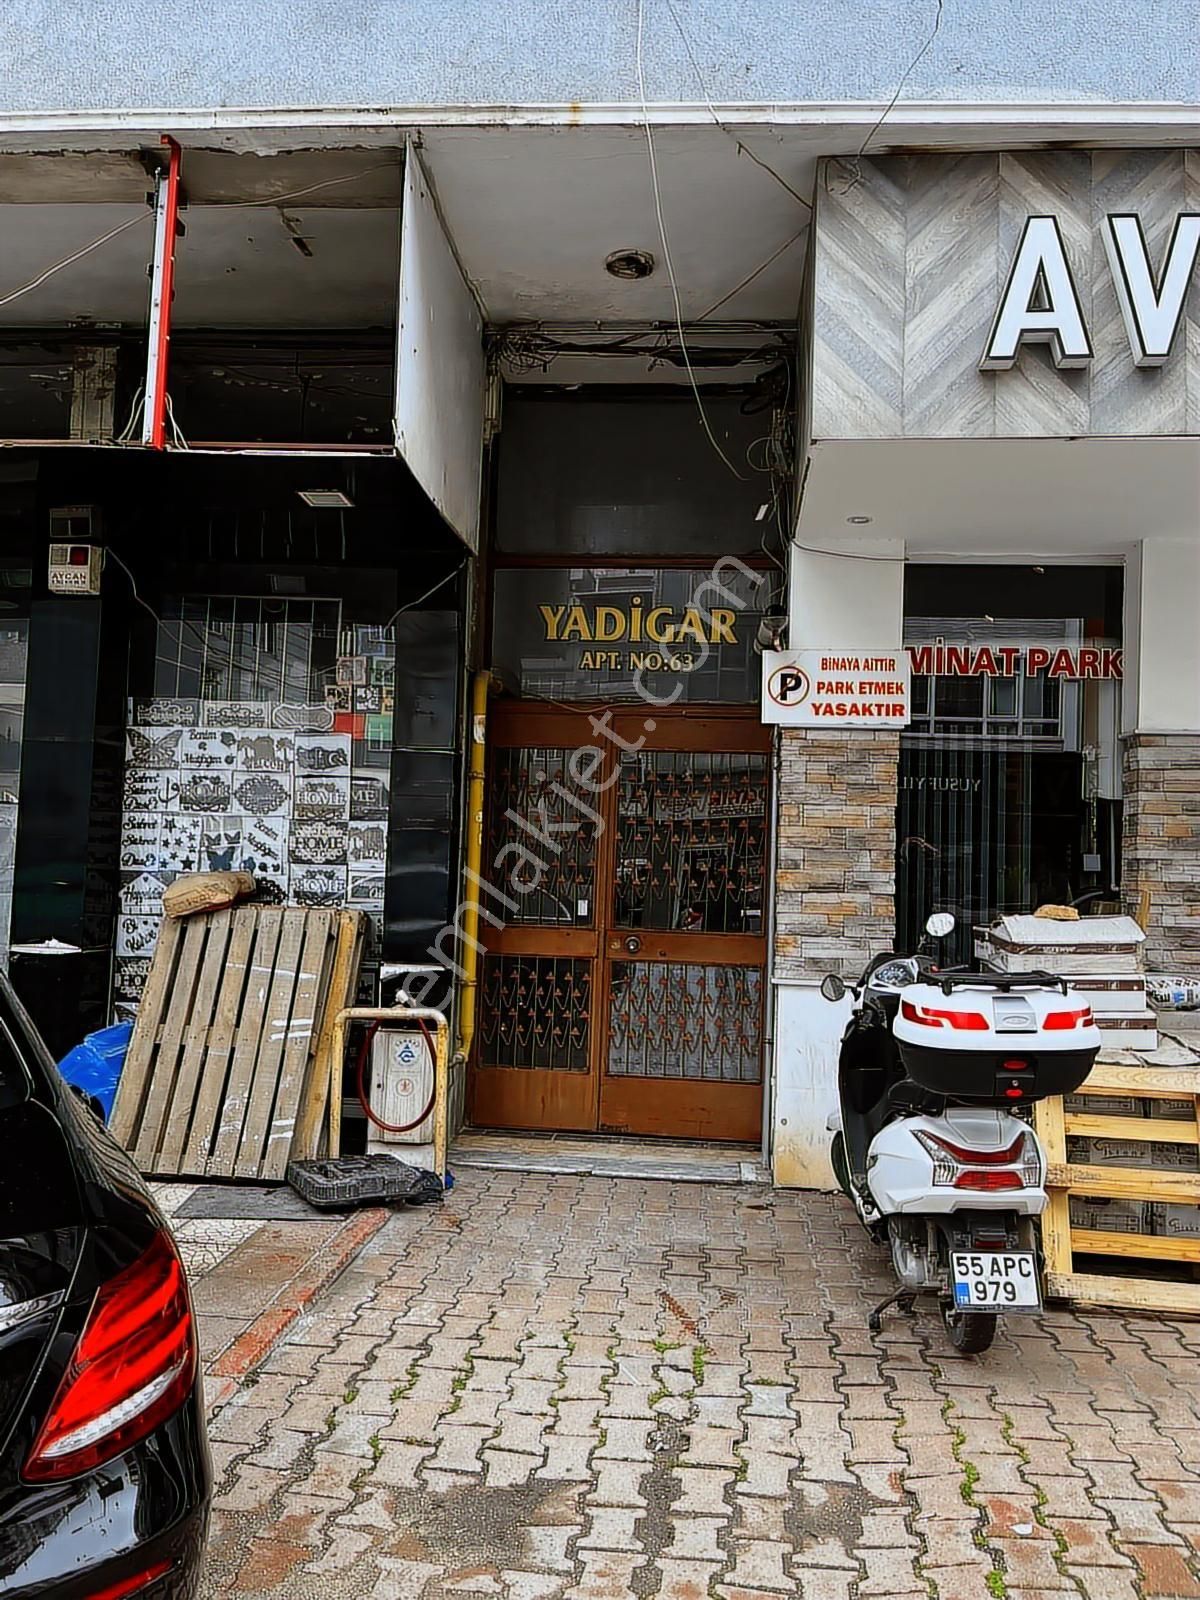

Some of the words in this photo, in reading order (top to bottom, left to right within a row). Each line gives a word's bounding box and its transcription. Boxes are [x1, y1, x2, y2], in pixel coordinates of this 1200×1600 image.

[979, 212, 1200, 371] AV
[538, 597, 740, 645] YADİGAR
[579, 651, 622, 671] APT.
[628, 652, 694, 673] NO:63
[1026, 646, 1124, 679] PARK
[816, 681, 854, 695] PARK
[858, 681, 905, 695] ETMEK
[811, 702, 906, 717] YASAKTIR
[295, 837, 344, 850] HOME
[956, 1256, 984, 1276] 55
[990, 1257, 1031, 1278] APC
[974, 1281, 1017, 1302] 979
